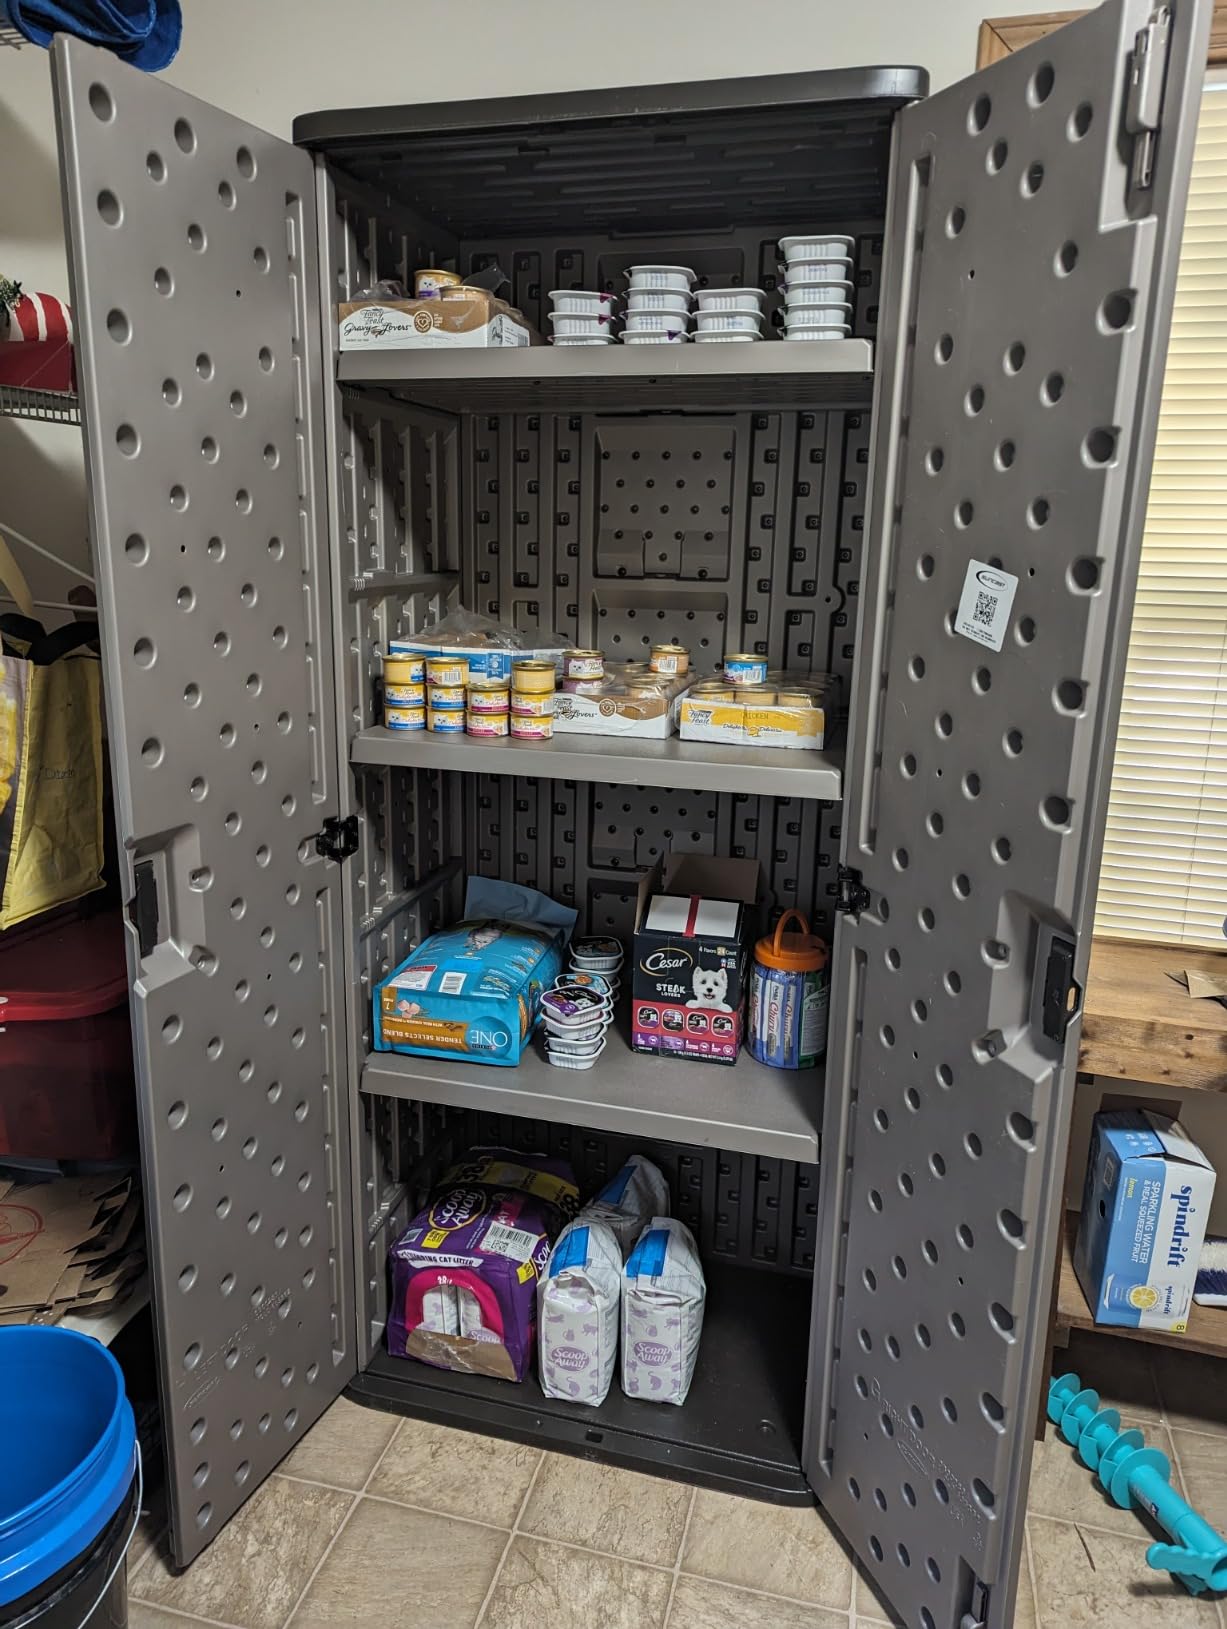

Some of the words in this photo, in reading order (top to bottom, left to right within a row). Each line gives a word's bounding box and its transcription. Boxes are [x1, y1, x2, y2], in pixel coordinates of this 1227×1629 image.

[344, 322, 371, 336] Gravy
[380, 322, 409, 336] Lovers
[645, 952, 688, 971] Cesar
[656, 983, 686, 994] STEAK
[768, 1002, 778, 1034] Churu
[383, 1028, 404, 1037] BLEND
[404, 1031, 434, 1041] SELECTS
[435, 1036, 462, 1044] TENDER
[470, 1029, 508, 1047] ONE
[1140, 1186, 1150, 1205] REAL
[434, 1188, 467, 1224] Scoop
[451, 1191, 483, 1225] Away
[1144, 1181, 1161, 1231] SPARKLING
[1134, 1205, 1147, 1242] SQUEEZED
[1167, 1185, 1195, 1267] spindrift
[1130, 1242, 1140, 1263] FRUIT
[1139, 1233, 1152, 1264] WATER
[1163, 1285, 1174, 1315] spindrift
[554, 1348, 588, 1360] Scoop
[637, 1342, 671, 1358] Scoop
[638, 1352, 668, 1363] Away
[555, 1358, 586, 1369] Away
